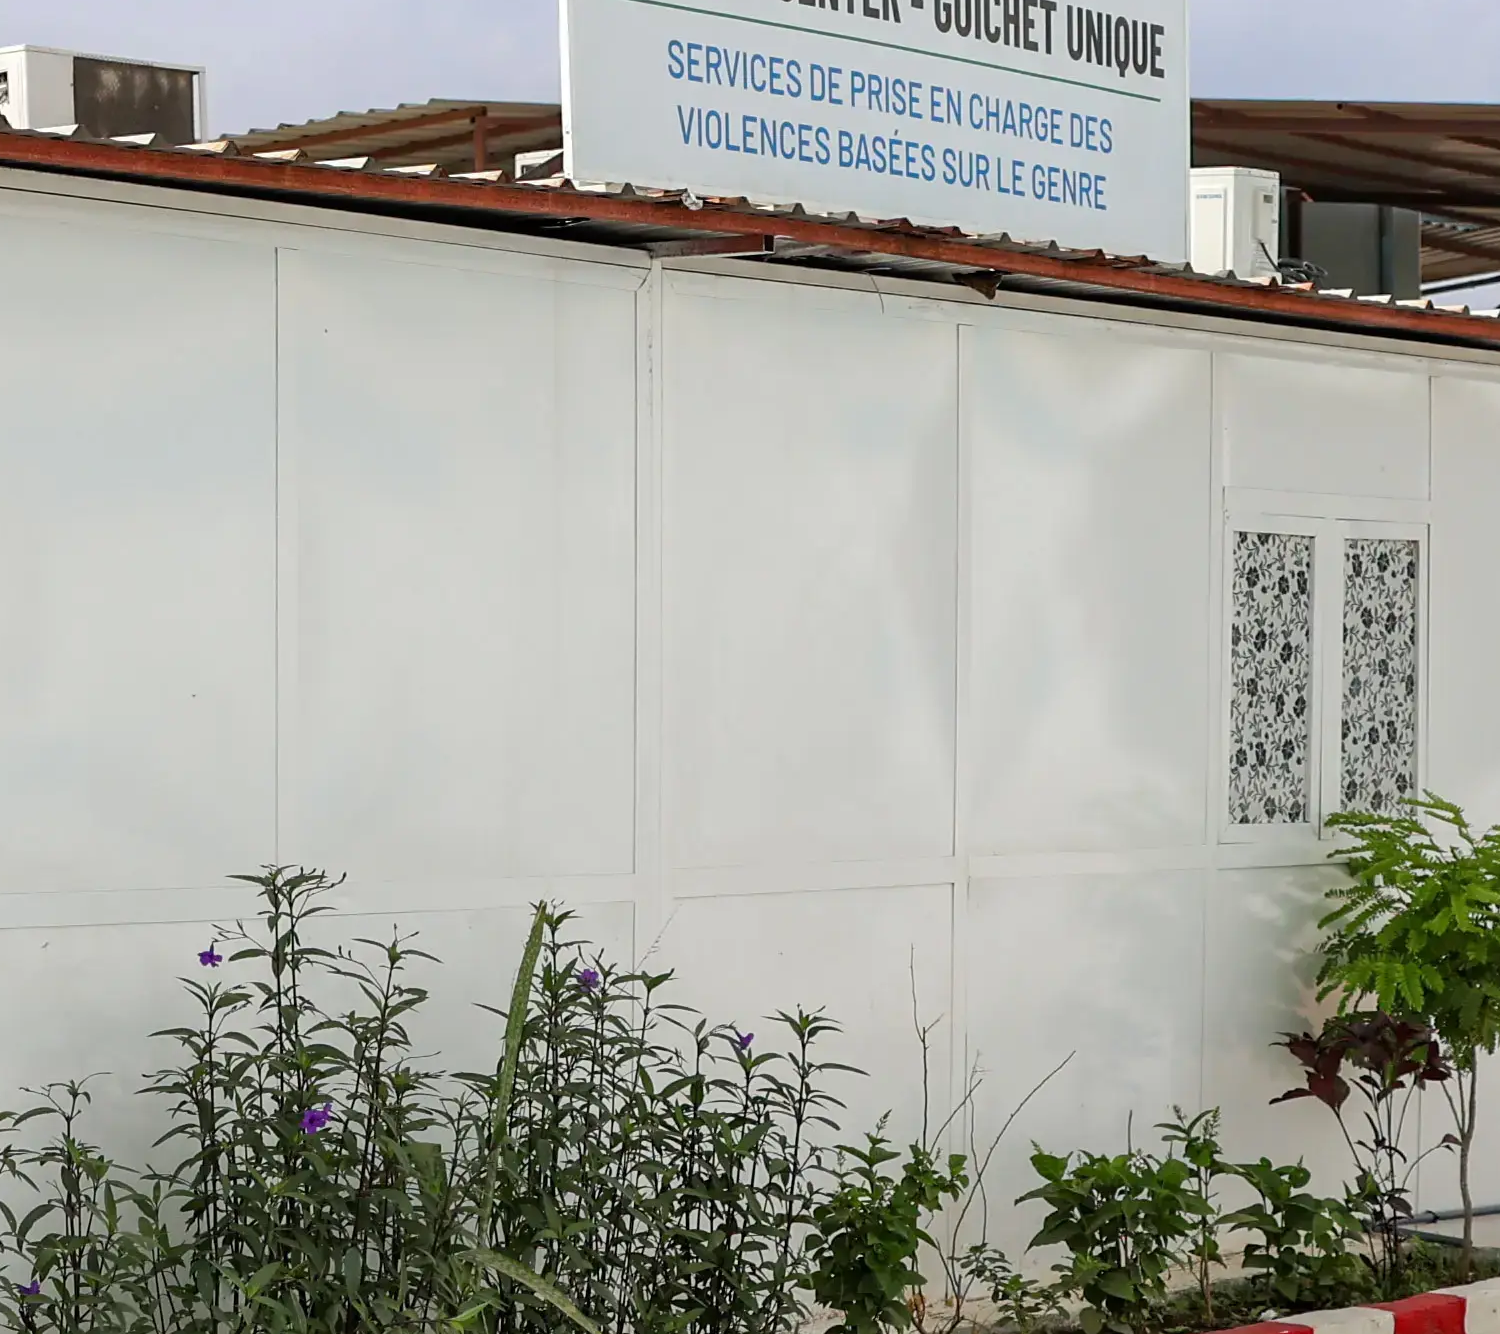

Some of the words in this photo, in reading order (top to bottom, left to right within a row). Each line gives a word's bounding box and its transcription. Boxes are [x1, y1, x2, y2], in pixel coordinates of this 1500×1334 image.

[1066, 4, 1165, 79] UNIQUE
[667, 39, 802, 98] SERVICES
[810, 63, 844, 105] DE
[850, 70, 924, 120] PRISE
[930, 85, 962, 127] EN
[969, 93, 1064, 145] CHARGE
[1070, 112, 1113, 154] DES
[676, 104, 831, 165] VIOLENCES
[838, 129, 936, 182] BASÉES
[942, 147, 991, 192] SUR
[997, 157, 1026, 197] LE
[1032, 163, 1107, 211] GENRE
